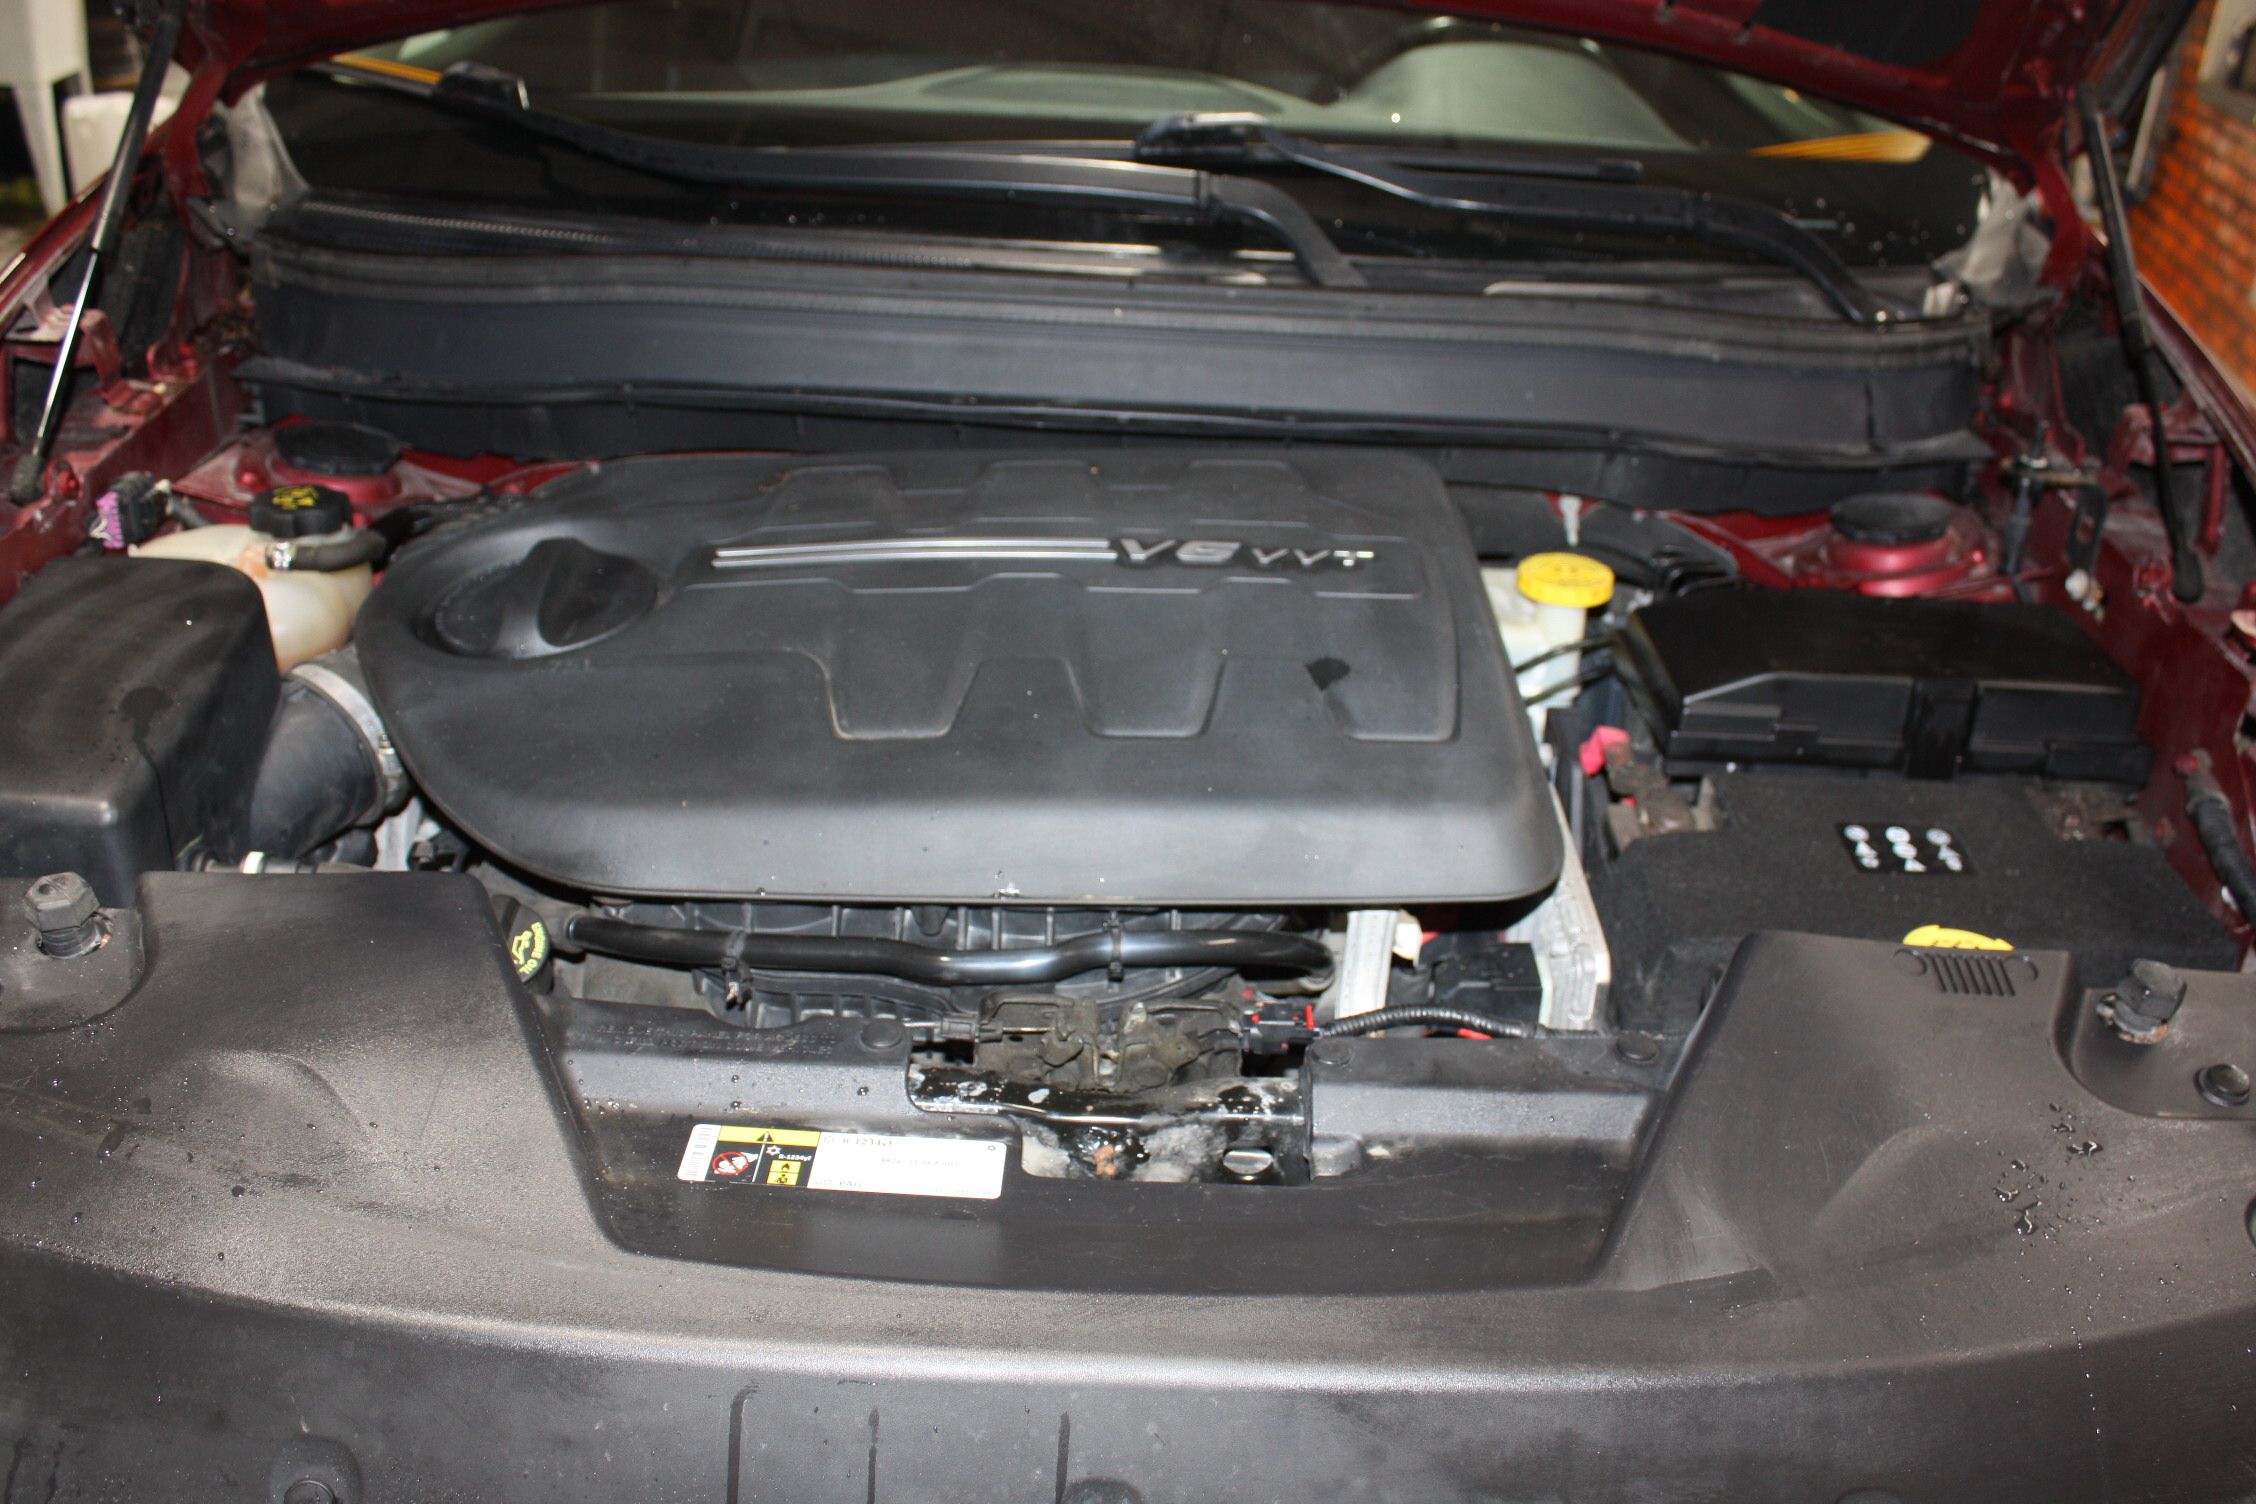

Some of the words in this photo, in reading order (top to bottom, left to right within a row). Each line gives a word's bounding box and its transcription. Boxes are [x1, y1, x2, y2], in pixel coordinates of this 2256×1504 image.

[1120, 539, 1241, 562] V6
[1252, 548, 1375, 566] VVT
[531, 921, 546, 958] ENGINE
[519, 959, 538, 975] OIL
[839, 1180, 862, 1188] PAG
